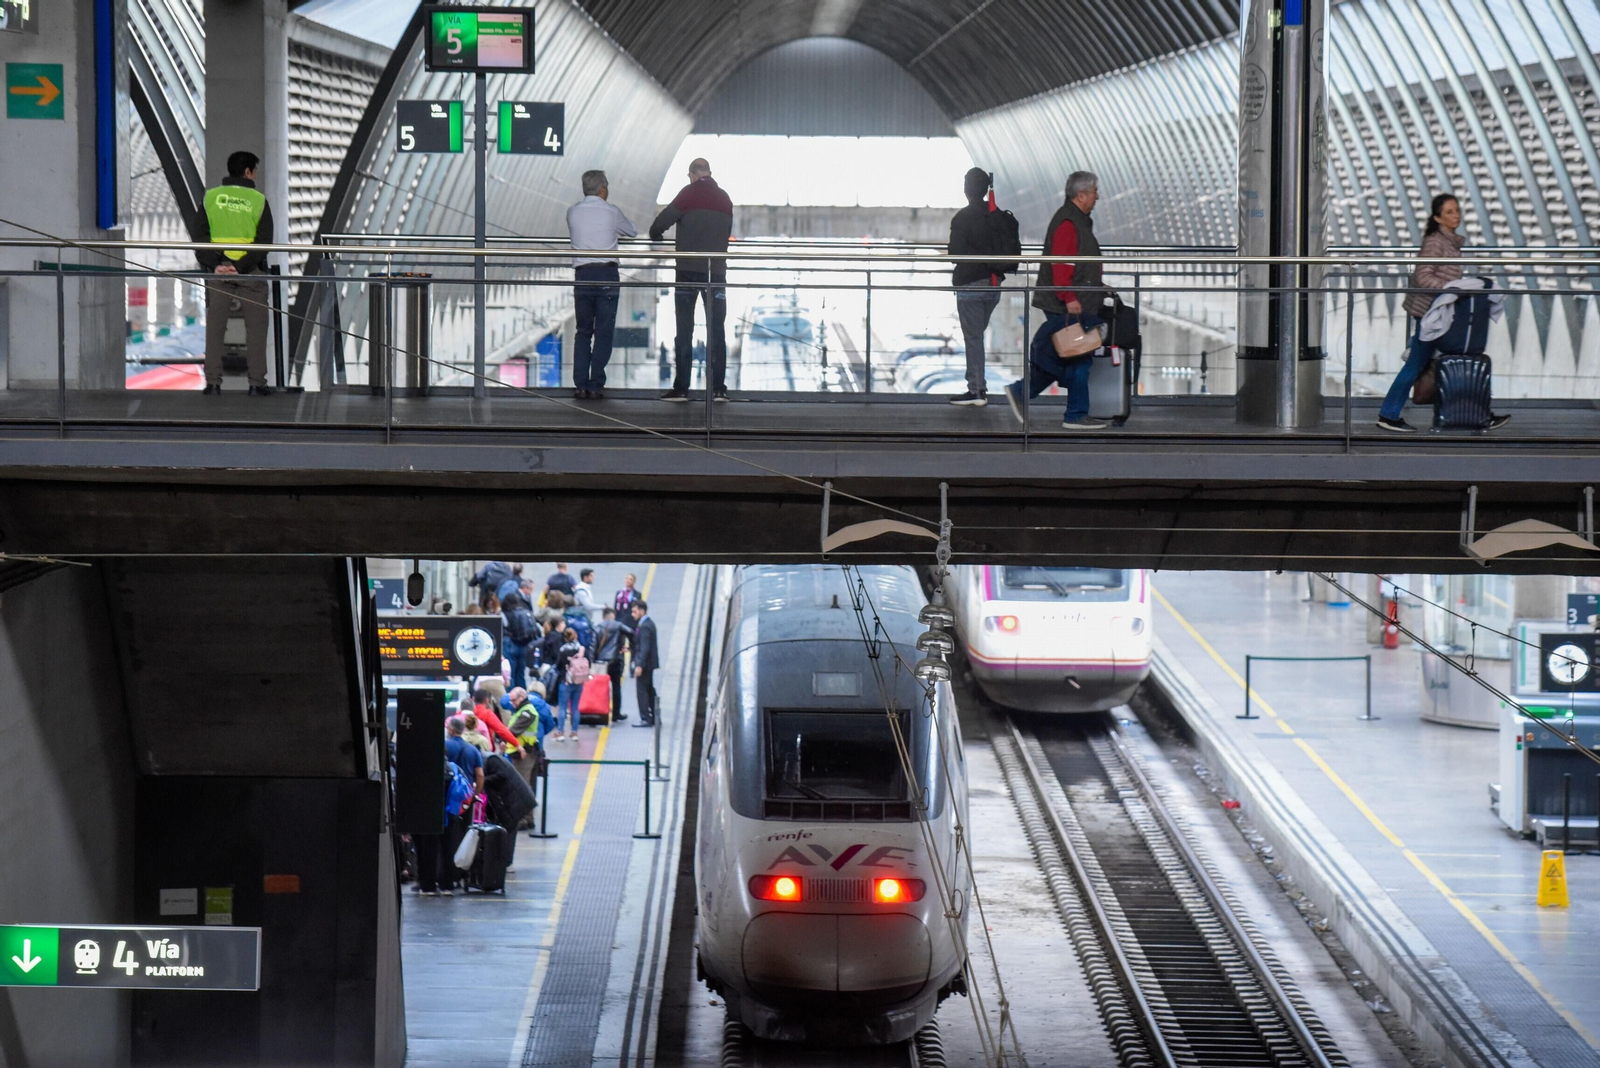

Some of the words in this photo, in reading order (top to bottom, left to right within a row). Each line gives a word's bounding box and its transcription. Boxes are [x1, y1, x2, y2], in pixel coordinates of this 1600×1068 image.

[447, 28, 462, 55] 5
[401, 125, 416, 151] 5
[543, 127, 561, 152] 4
[391, 593, 403, 609] 4
[1568, 608, 1578, 624] 3
[400, 712, 412, 730] 4
[767, 829, 813, 842] renfe
[767, 844, 915, 871] AVE
[113, 940, 139, 976] 4
[146, 938, 180, 959] Vía
[145, 966, 204, 977] PLATFORM
